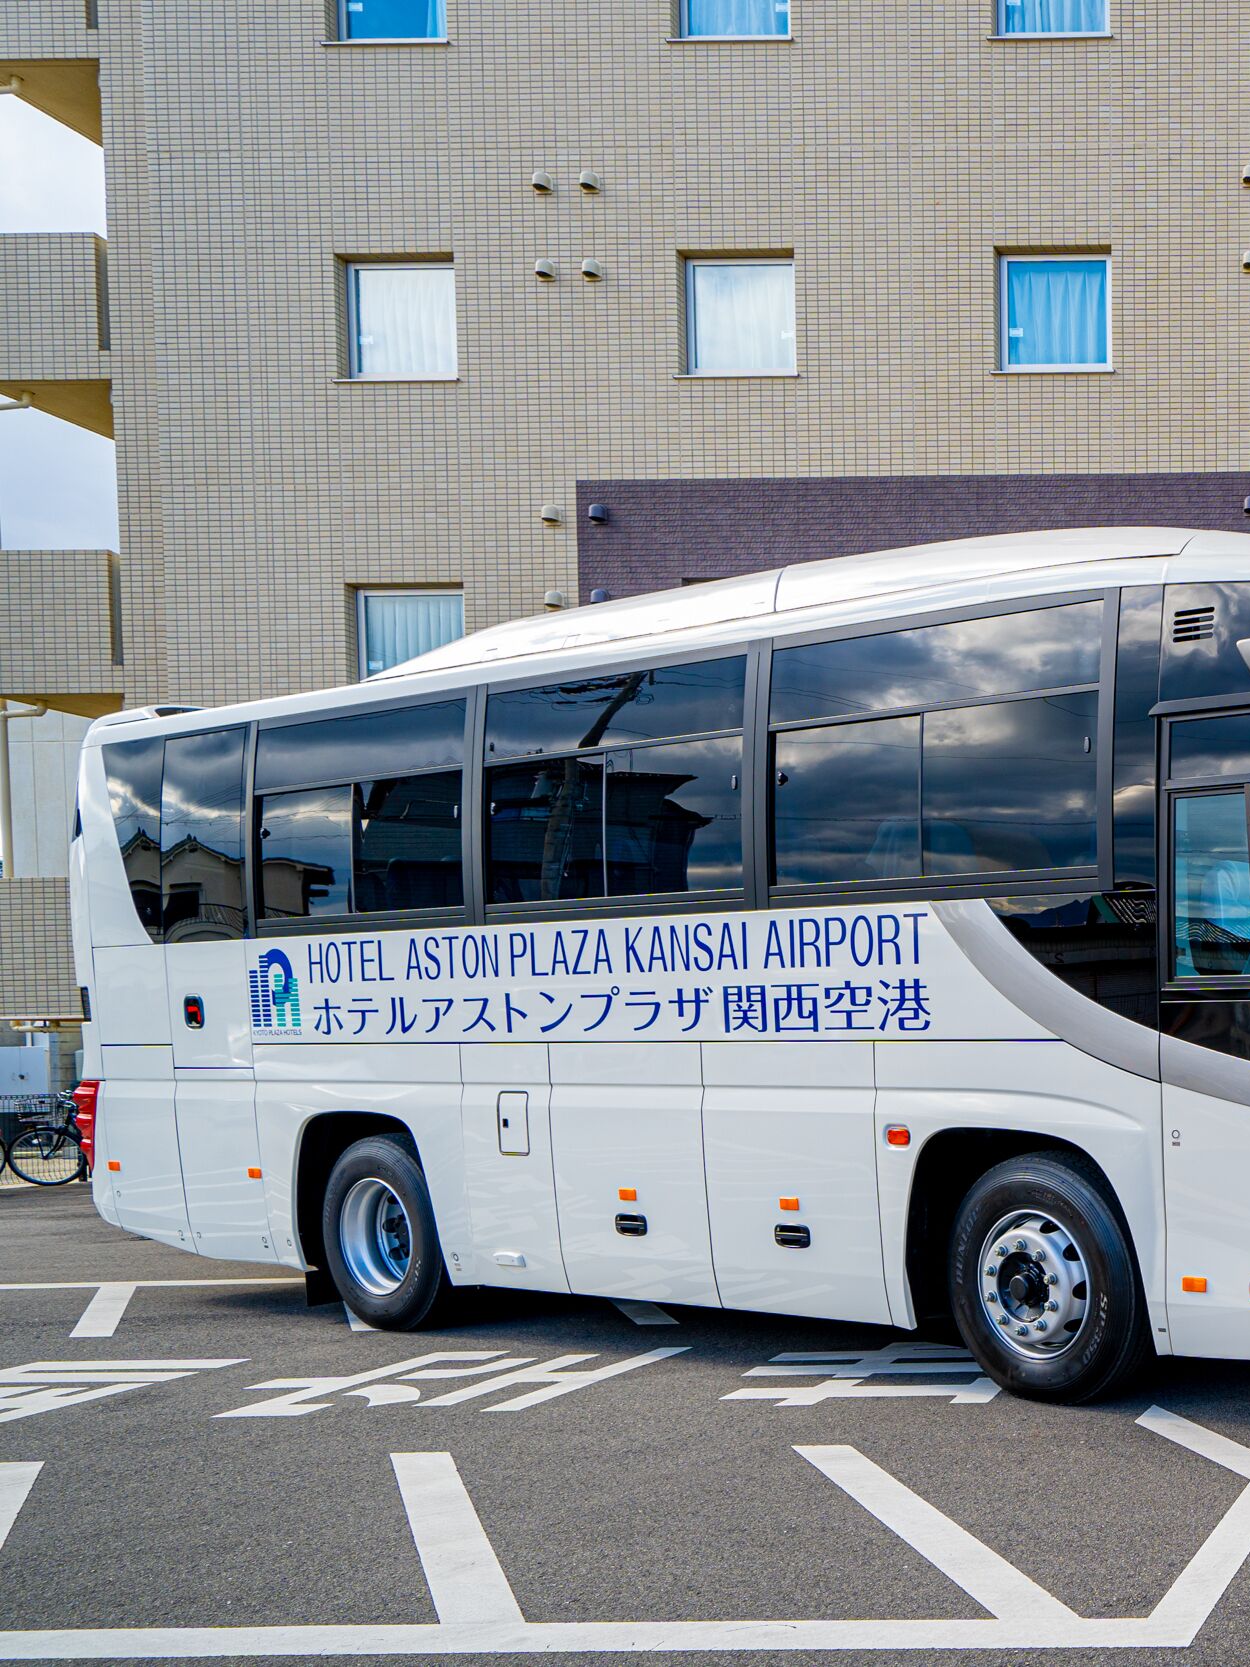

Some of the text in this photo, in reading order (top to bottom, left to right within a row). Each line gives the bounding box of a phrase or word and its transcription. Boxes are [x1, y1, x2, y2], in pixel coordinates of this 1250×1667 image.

[307, 912, 928, 984] HOTEL ASTON PLAZA KANSAI AIRPORT
[313, 978, 931, 1036] ホテルアストンプラザ関西空港
